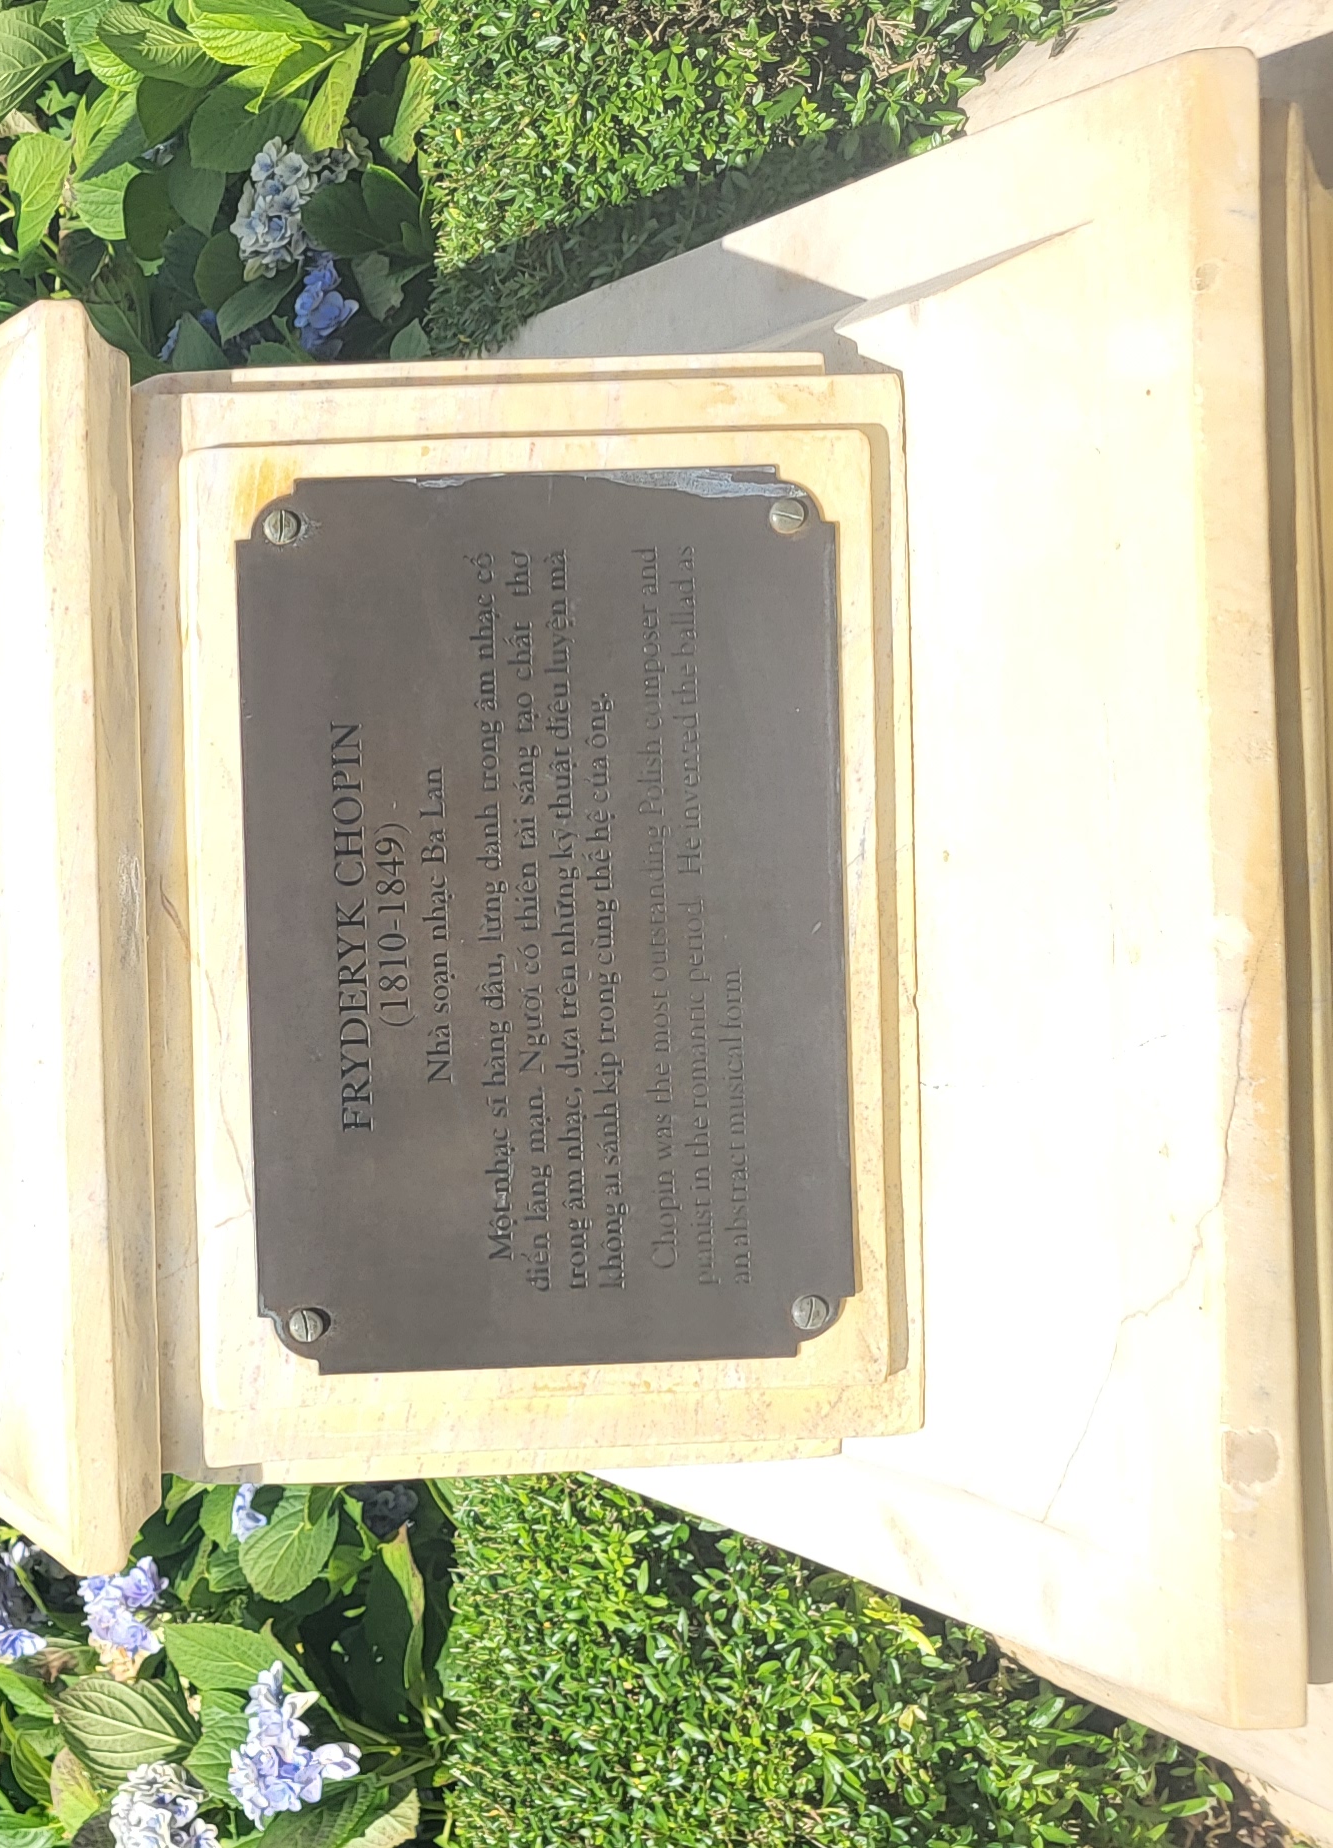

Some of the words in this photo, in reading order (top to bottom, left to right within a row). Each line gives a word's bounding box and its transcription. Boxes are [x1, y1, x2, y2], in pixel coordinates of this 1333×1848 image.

[504, 549, 532, 598] thơ
[542, 548, 568, 592] mà
[630, 545, 659, 597] and
[676, 545, 696, 571] as
[469, 594, 502, 661] nhạc
[542, 596, 577, 675] luyện
[669, 577, 697, 657] ballad
[502, 620, 534, 682] chất
[638, 603, 668, 731] composer
[473, 667, 498, 712] âm
[515, 691, 541, 733] tạo
[543, 679, 572, 741] điêu
[670, 662, 699, 705] the
[583, 691, 615, 750] ông.
[477, 719, 504, 793] trong
[512, 744, 542, 806] sáng
[546, 746, 578, 820] thuật
[583, 754, 611, 804] của
[636, 736, 665, 817] Polish
[671, 712, 703, 830] invented
[330, 720, 367, 887] CHOPIN
[418, 765, 445, 819] Lan
[419, 827, 448, 866] Ba
[474, 801, 502, 872] danh
[512, 815, 538, 850] tài
[548, 827, 582, 860] kỹ
[584, 807, 615, 843] hệ
[675, 836, 704, 876] He
[512, 859, 540, 932] thiên
[581, 848, 614, 892] thế
[373, 822, 416, 1028] (1810-1849)
[422, 876, 455, 941] nhạc
[477, 880, 509, 943] lừng
[549, 865, 582, 957] những
[589, 898, 620, 966] cùng
[639, 824, 673, 983] outstanding
[431, 950, 455, 1015] soạn
[475, 952, 507, 1010] đầu,
[516, 943, 542, 976] có
[334, 897, 374, 1133] FRYDERYK
[554, 963, 580, 1020] trên
[593, 972, 622, 1045] trong
[648, 989, 671, 1053] most
[425, 1023, 453, 1084] Nhà
[481, 1020, 513, 1088] hàng
[517, 984, 551, 1075] Người
[554, 1026, 588, 1079] dựa
[682, 991, 711, 1110] romantic
[591, 1051, 625, 1096] kịp
[645, 1061, 674, 1104] the
[717, 1036, 747, 1136] musical
[487, 1095, 510, 1119] sĩ
[526, 1086, 552, 1155] mạn.
[556, 1086, 587, 1162] nhạc,
[593, 1099, 623, 1166] sánh
[655, 1113, 674, 1161] was
[684, 1115, 712, 1159] the
[484, 1127, 515, 1195] nhạc
[561, 1165, 586, 1211] âm
[600, 1170, 622, 1196] ai
[689, 1164, 713, 1192] in
[523, 1164, 554, 1223] lãng
[649, 1168, 682, 1270] Chopin
[723, 1141, 751, 1247] abstract
[486, 1200, 517, 1261] Một
[566, 1216, 593, 1290] trong
[597, 1202, 629, 1290] không
[689, 1197, 721, 1286] pianist
[731, 1250, 753, 1285] an
